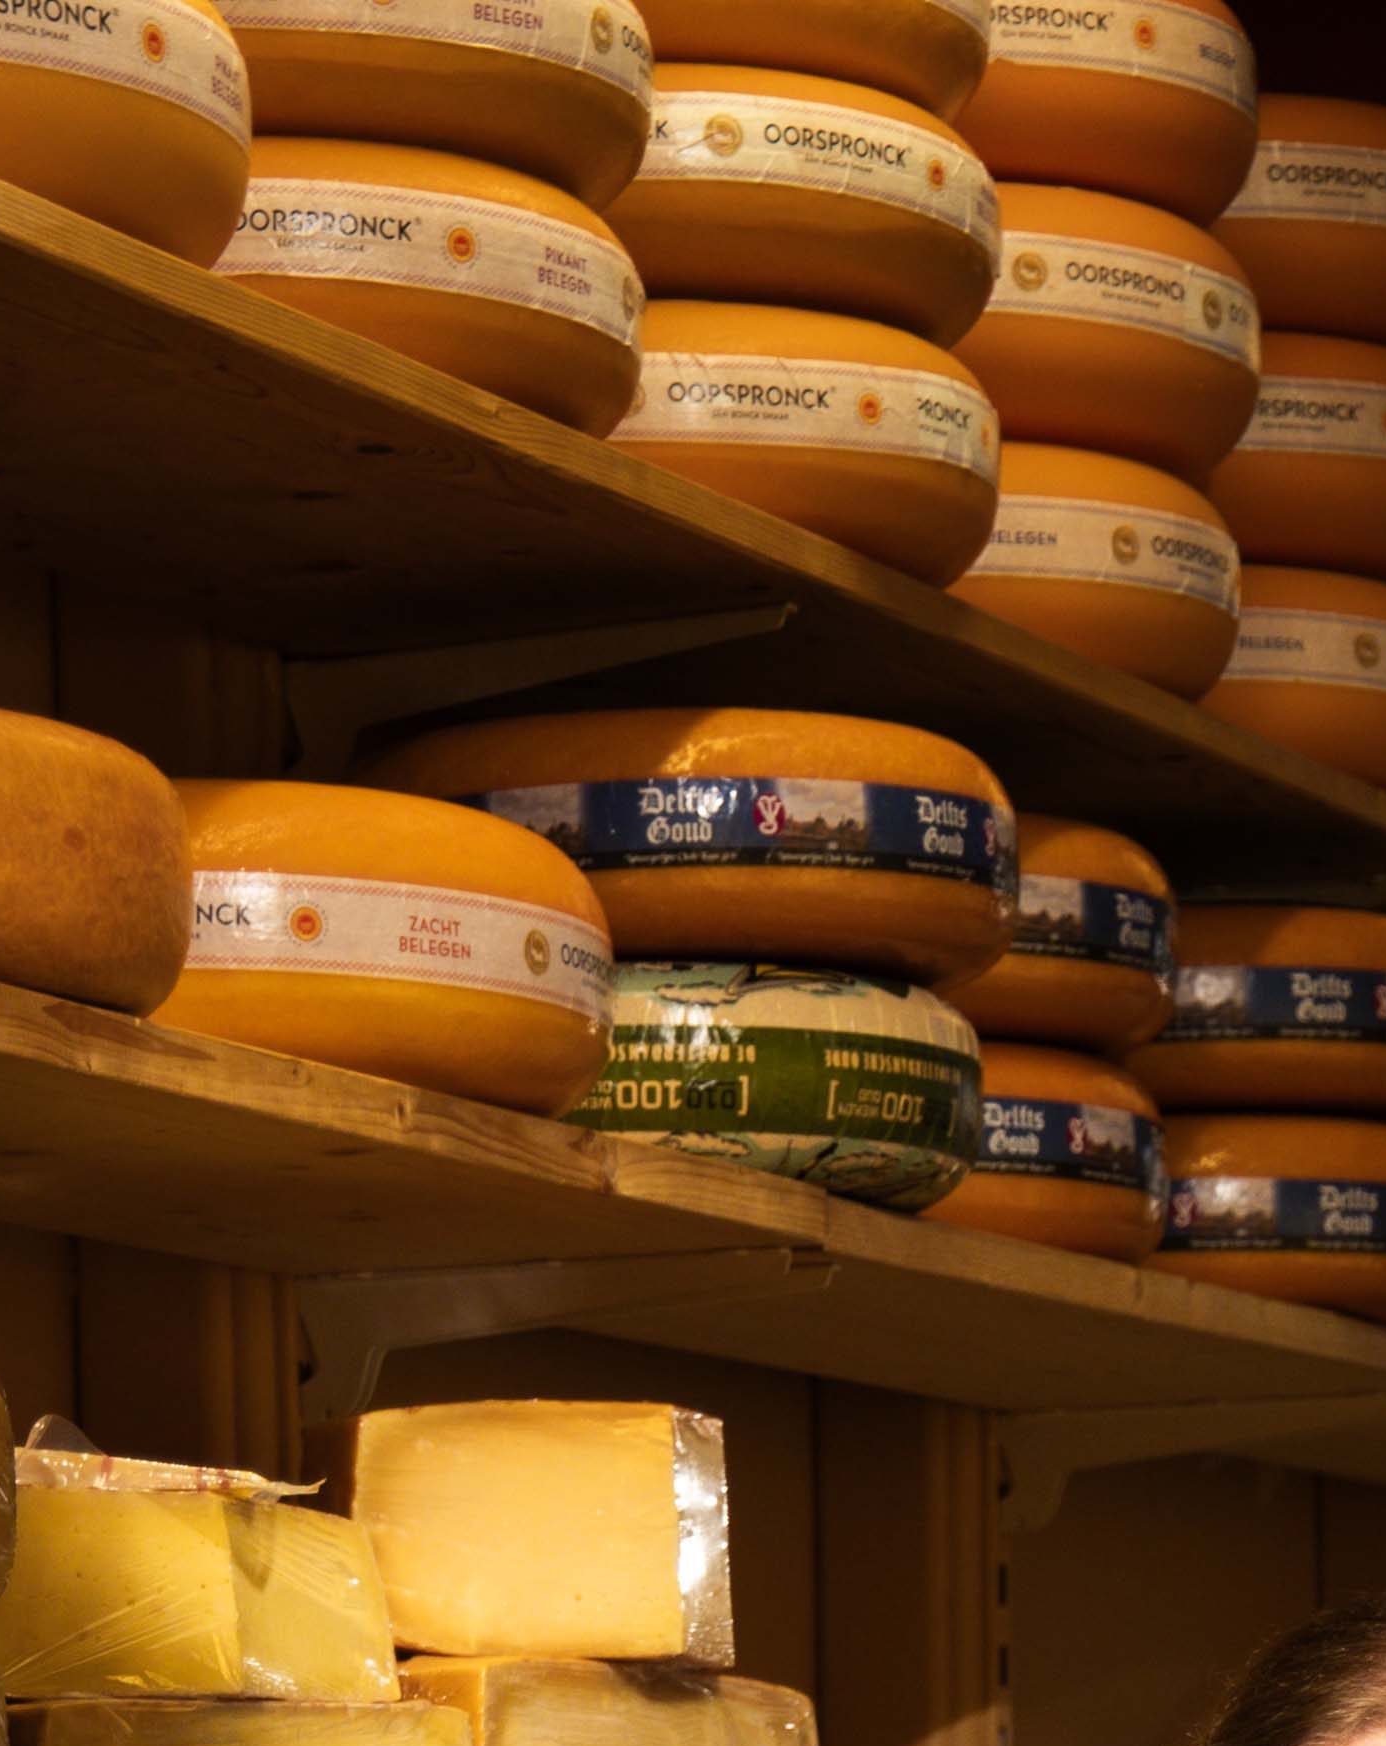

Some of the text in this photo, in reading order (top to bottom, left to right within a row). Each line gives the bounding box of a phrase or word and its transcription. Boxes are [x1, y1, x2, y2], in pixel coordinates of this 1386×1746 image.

[473, 2, 543, 31] BELEGEN
[764, 123, 909, 169] OORSPRONCK
[545, 246, 589, 275] PIKANT
[537, 266, 593, 298] BELEGEN
[667, 382, 831, 411] OORSPRONCK
[917, 796, 969, 829] Delfts
[647, 815, 714, 845] Goud
[922, 828, 964, 858] Goud
[408, 914, 462, 938] ZACHT
[398, 936, 472, 960] BELEGEN
[1291, 972, 1354, 998] Delfts
[616, 1079, 685, 1111] 100
[981, 1101, 1045, 1132] Delfts
[987, 1126, 1041, 1157] Goud
